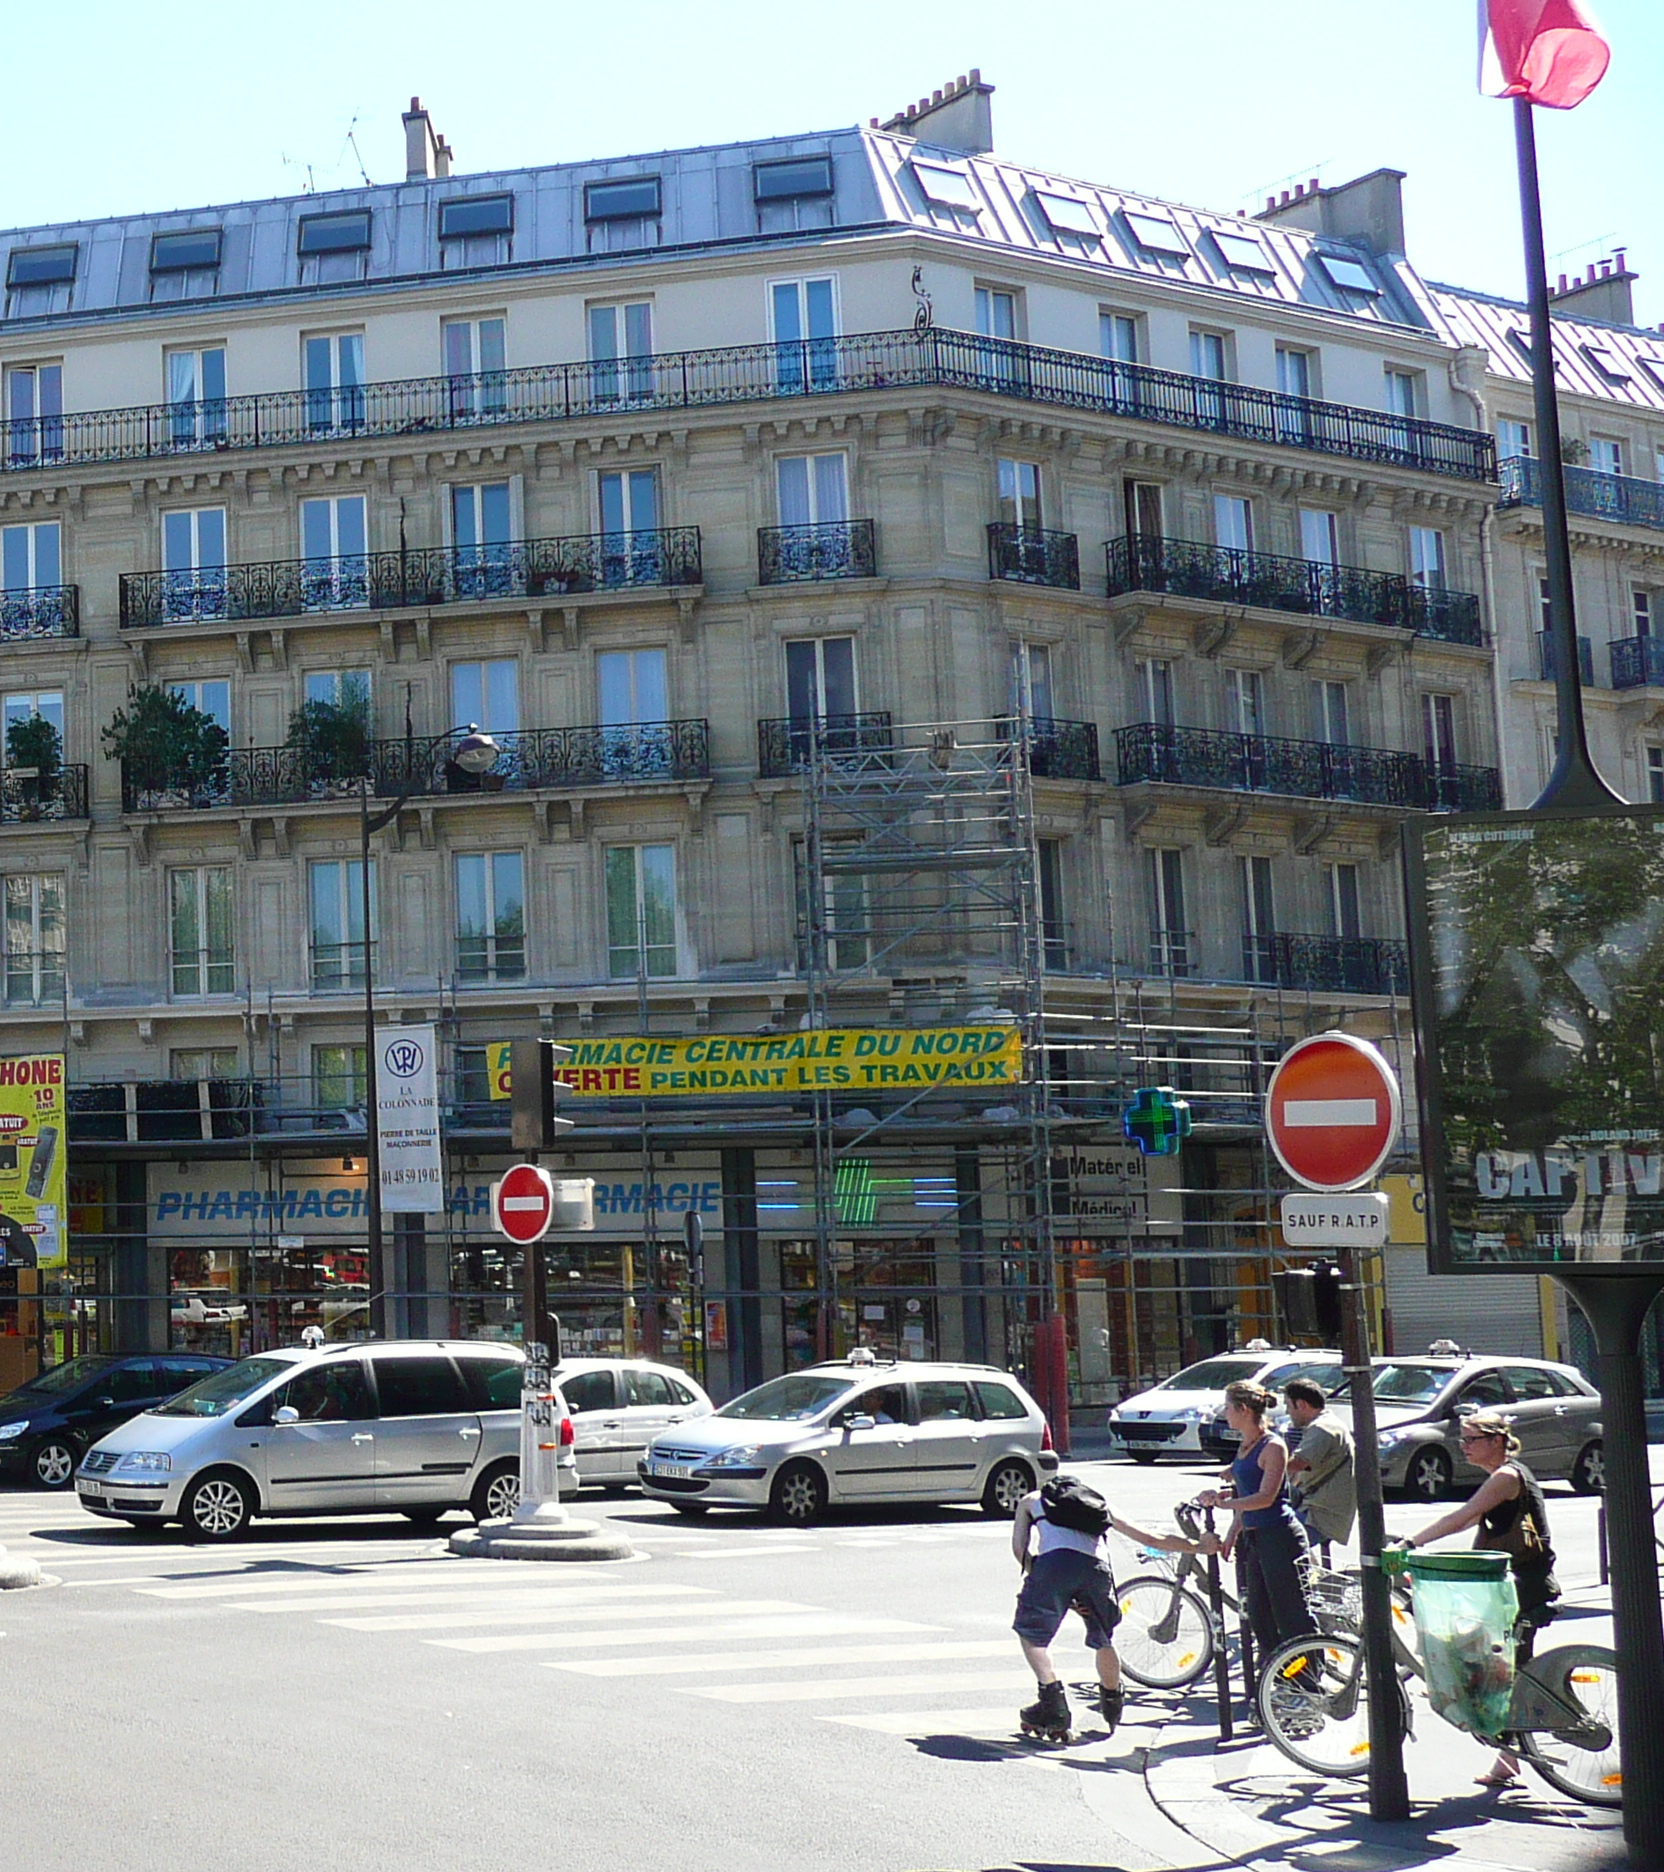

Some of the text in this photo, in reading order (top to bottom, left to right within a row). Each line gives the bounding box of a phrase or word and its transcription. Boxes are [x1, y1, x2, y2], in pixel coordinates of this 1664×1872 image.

[497, 1030, 1005, 1069] PRMACIE CENTRALE DU NORD
[497, 1060, 1009, 1092] OERTE PENDANT LES TRAVAUX
[33, 1087, 54, 1102] 10
[399, 1086, 413, 1096] LA
[35, 1101, 55, 1110] ANS
[378, 1096, 436, 1110] COLONNADE
[380, 1128, 438, 1138] PIERRE DE TAILLE
[1070, 1156, 1141, 1175] Matérel
[1287, 1214, 1326, 1228] SAUF
[1536, 1234, 1551, 1247] LE
[1603, 1232, 1637, 1247] 2007
